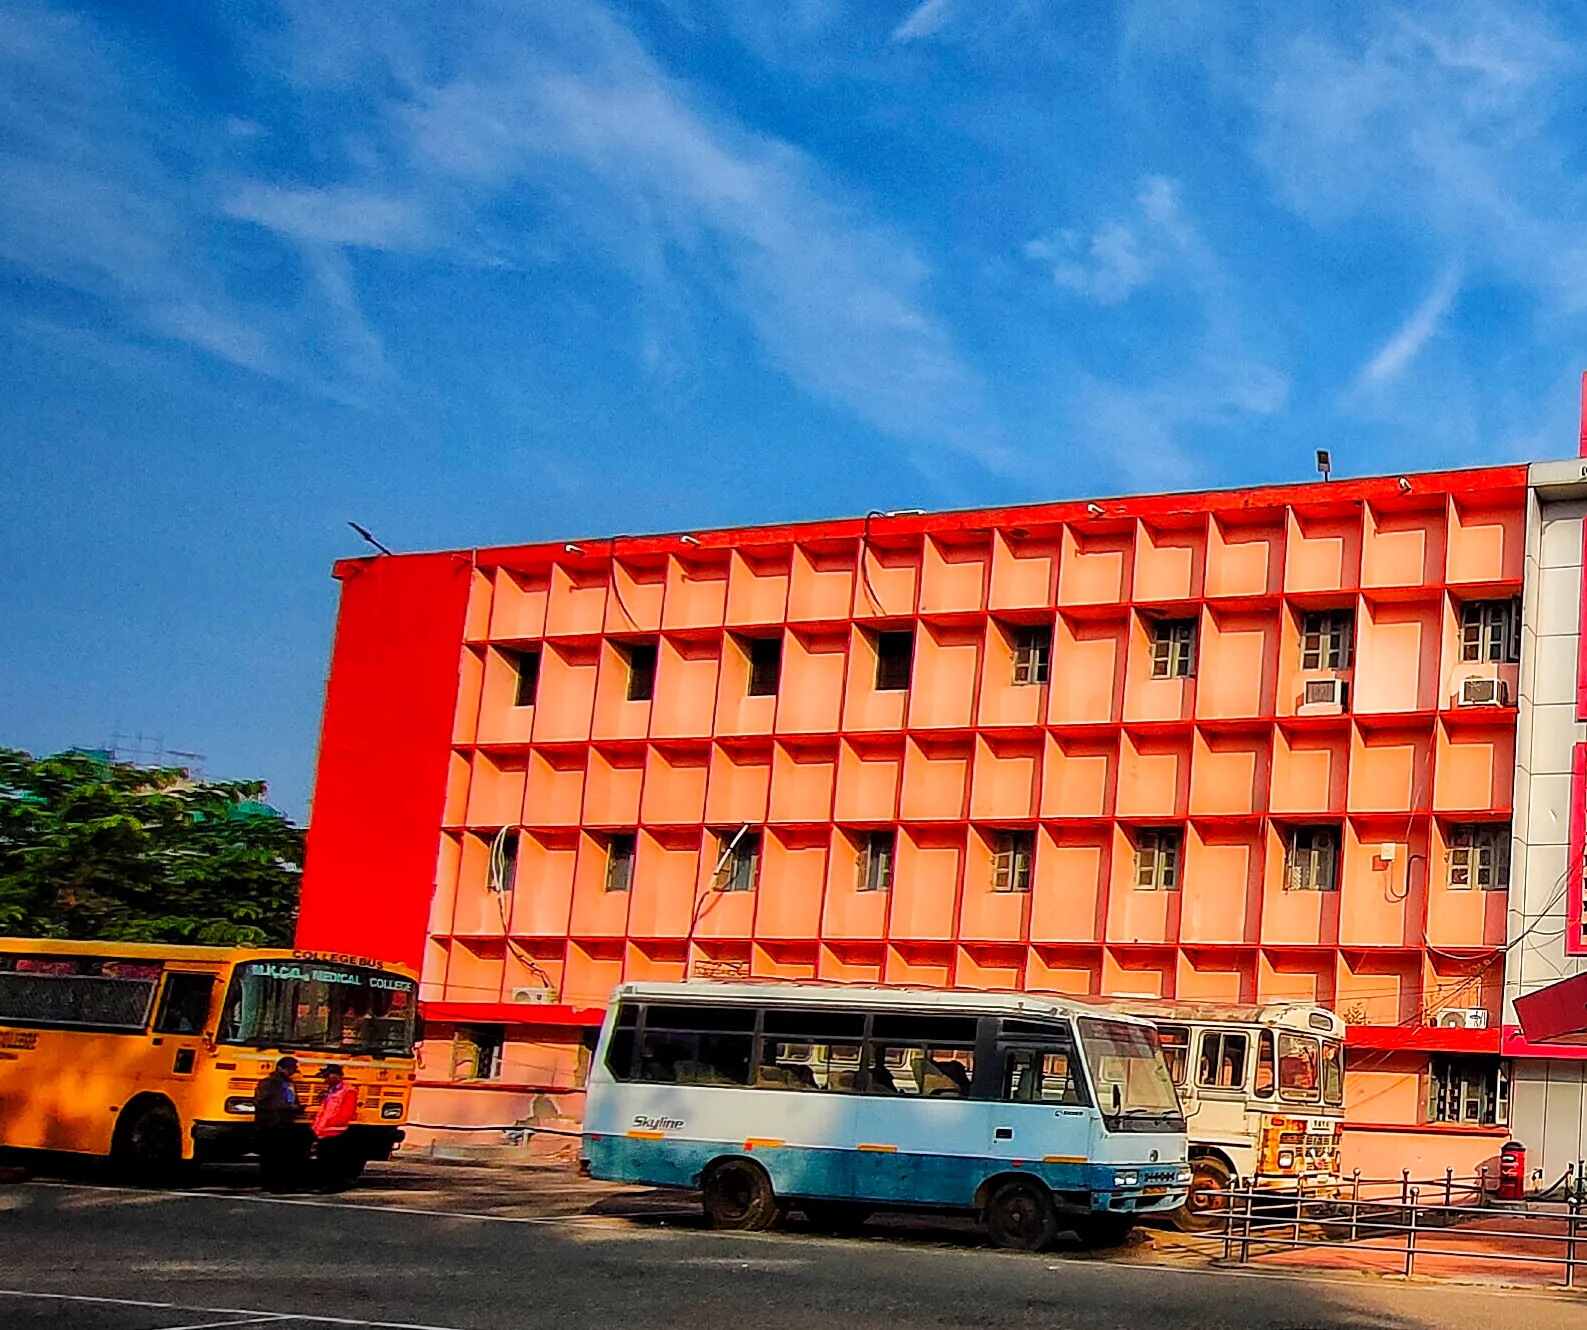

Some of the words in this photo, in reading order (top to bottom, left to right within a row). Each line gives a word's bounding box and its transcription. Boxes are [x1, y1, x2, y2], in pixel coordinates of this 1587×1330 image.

[293, 951, 356, 965] COLLEGE
[358, 957, 384, 971] BUS
[312, 969, 363, 986] MEDICAL
[369, 977, 413, 993] COLLEGE
[632, 1115, 684, 1131] Skyline
